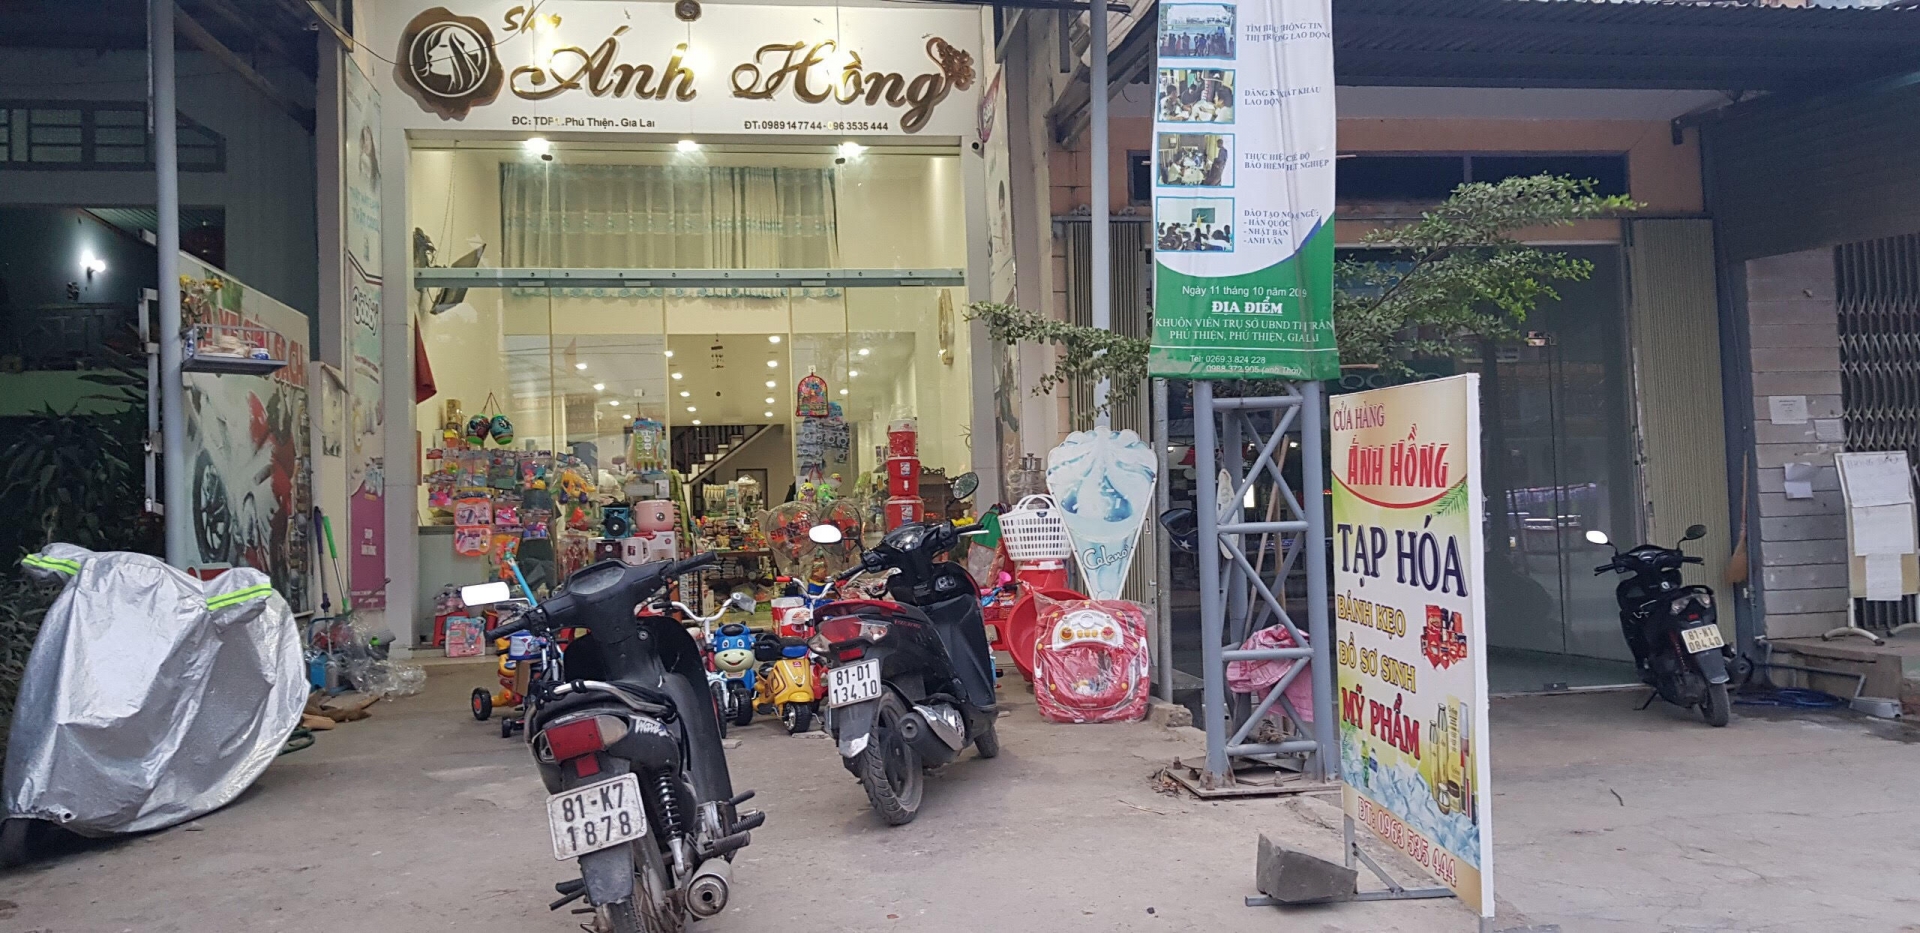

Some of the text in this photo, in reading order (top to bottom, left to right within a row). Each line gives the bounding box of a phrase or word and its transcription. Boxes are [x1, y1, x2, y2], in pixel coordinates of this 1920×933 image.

[511, 25, 697, 101] Ánh
[732, 38, 945, 133] Hồng
[1244, 98, 1262, 106] LAO
[511, 116, 531, 125] ĐC:
[1182, 285, 1307, 298] Ngày 11 tháng 10 năm 209
[1211, 296, 1283, 315] ĐỊA ĐIỂM
[1155, 316, 1194, 328] KHUÔN
[1196, 317, 1221, 328] VIÊN
[1223, 319, 1243, 330] TRỤ
[1245, 317, 1259, 329] SỞ
[1261, 320, 1290, 330] UBND
[1229, 329, 1250, 340] PHÚ
[1189, 354, 1204, 363] Tel:
[1333, 400, 1385, 432] CỬA HÀNG
[1347, 423, 1449, 488] ÁNH HỒNG
[1337, 513, 1468, 598] TẠP HÓA
[1337, 590, 1407, 640] BÁNH KẸO
[836, 664, 870, 686] 81-D1
[1338, 631, 1417, 694] ĐỒ SƠ SINH
[833, 679, 877, 704] 134.10
[1341, 684, 1366, 730] MỸ
[1369, 693, 1421, 761] PHẨM
[562, 782, 623, 823] 81-K7
[567, 811, 631, 851] 1878
[1358, 796, 1457, 888] ĐT: 0963 535 444
